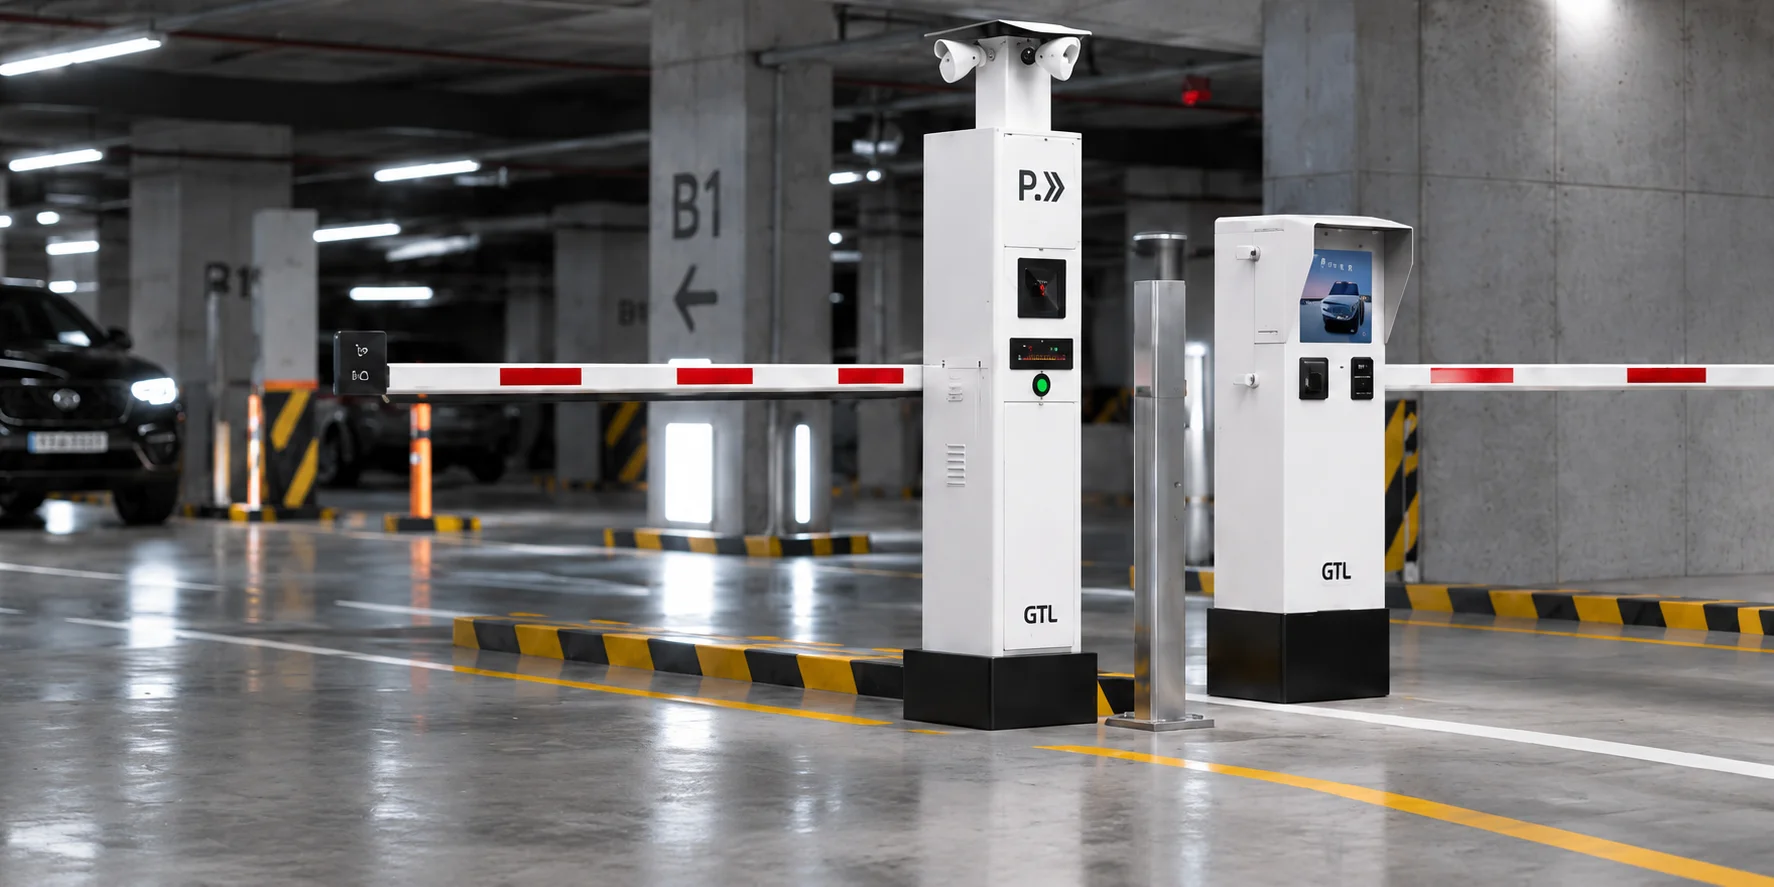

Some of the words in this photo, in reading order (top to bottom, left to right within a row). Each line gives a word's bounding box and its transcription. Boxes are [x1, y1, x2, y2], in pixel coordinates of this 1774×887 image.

[672, 171, 721, 239] B1
[1322, 561, 1352, 581] GTL
[1023, 604, 1058, 624] GTL
